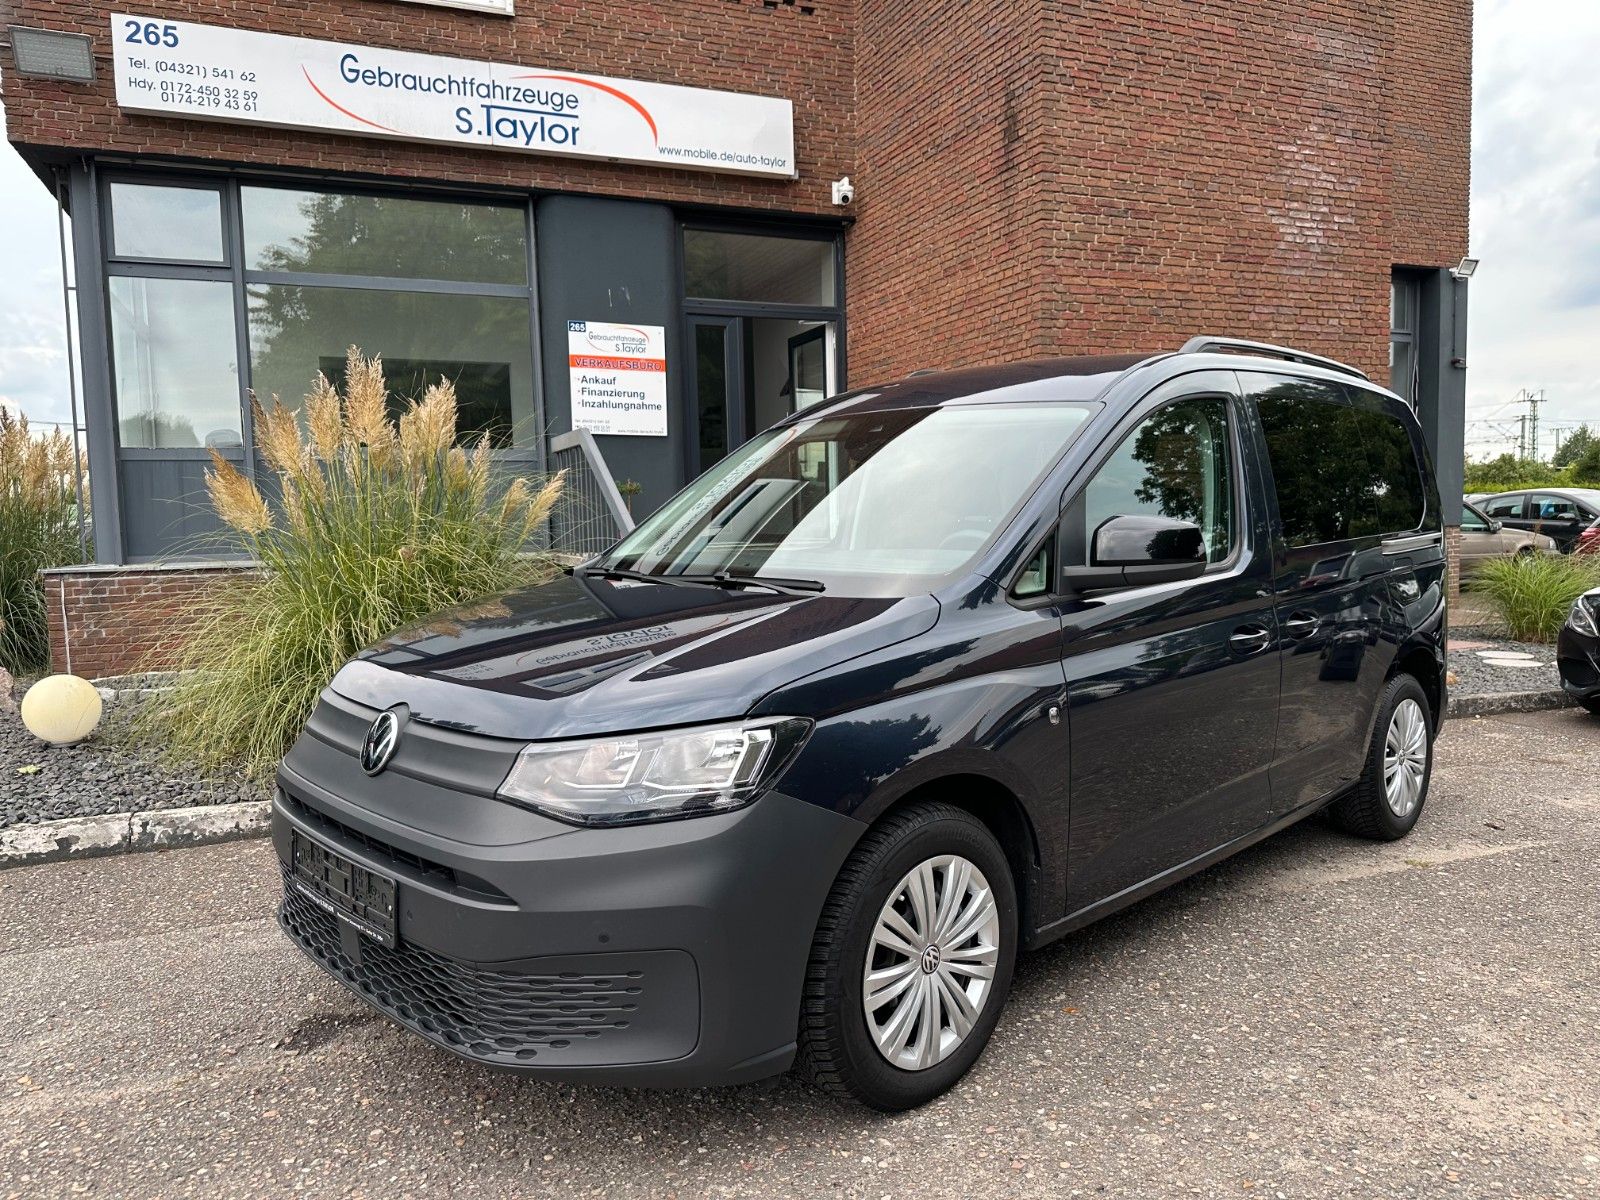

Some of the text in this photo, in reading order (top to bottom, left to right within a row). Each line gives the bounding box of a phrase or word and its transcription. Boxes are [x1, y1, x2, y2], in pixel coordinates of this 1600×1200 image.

[125, 20, 179, 48] 265
[128, 57, 256, 82] Tel. (04321) 541 62
[340, 53, 579, 111] Gebrauchtfahrzeuge
[128, 77, 258, 102] Hdy. 0172-450 32 59
[161, 92, 258, 112] 0174-219 43 61
[455, 104, 580, 146] S.Taylor
[658, 145, 787, 168] www.mobile.de/auto-taylor
[570, 322, 585, 332] 265
[588, 331, 646, 345] Gebrauchtfahrzeuge
